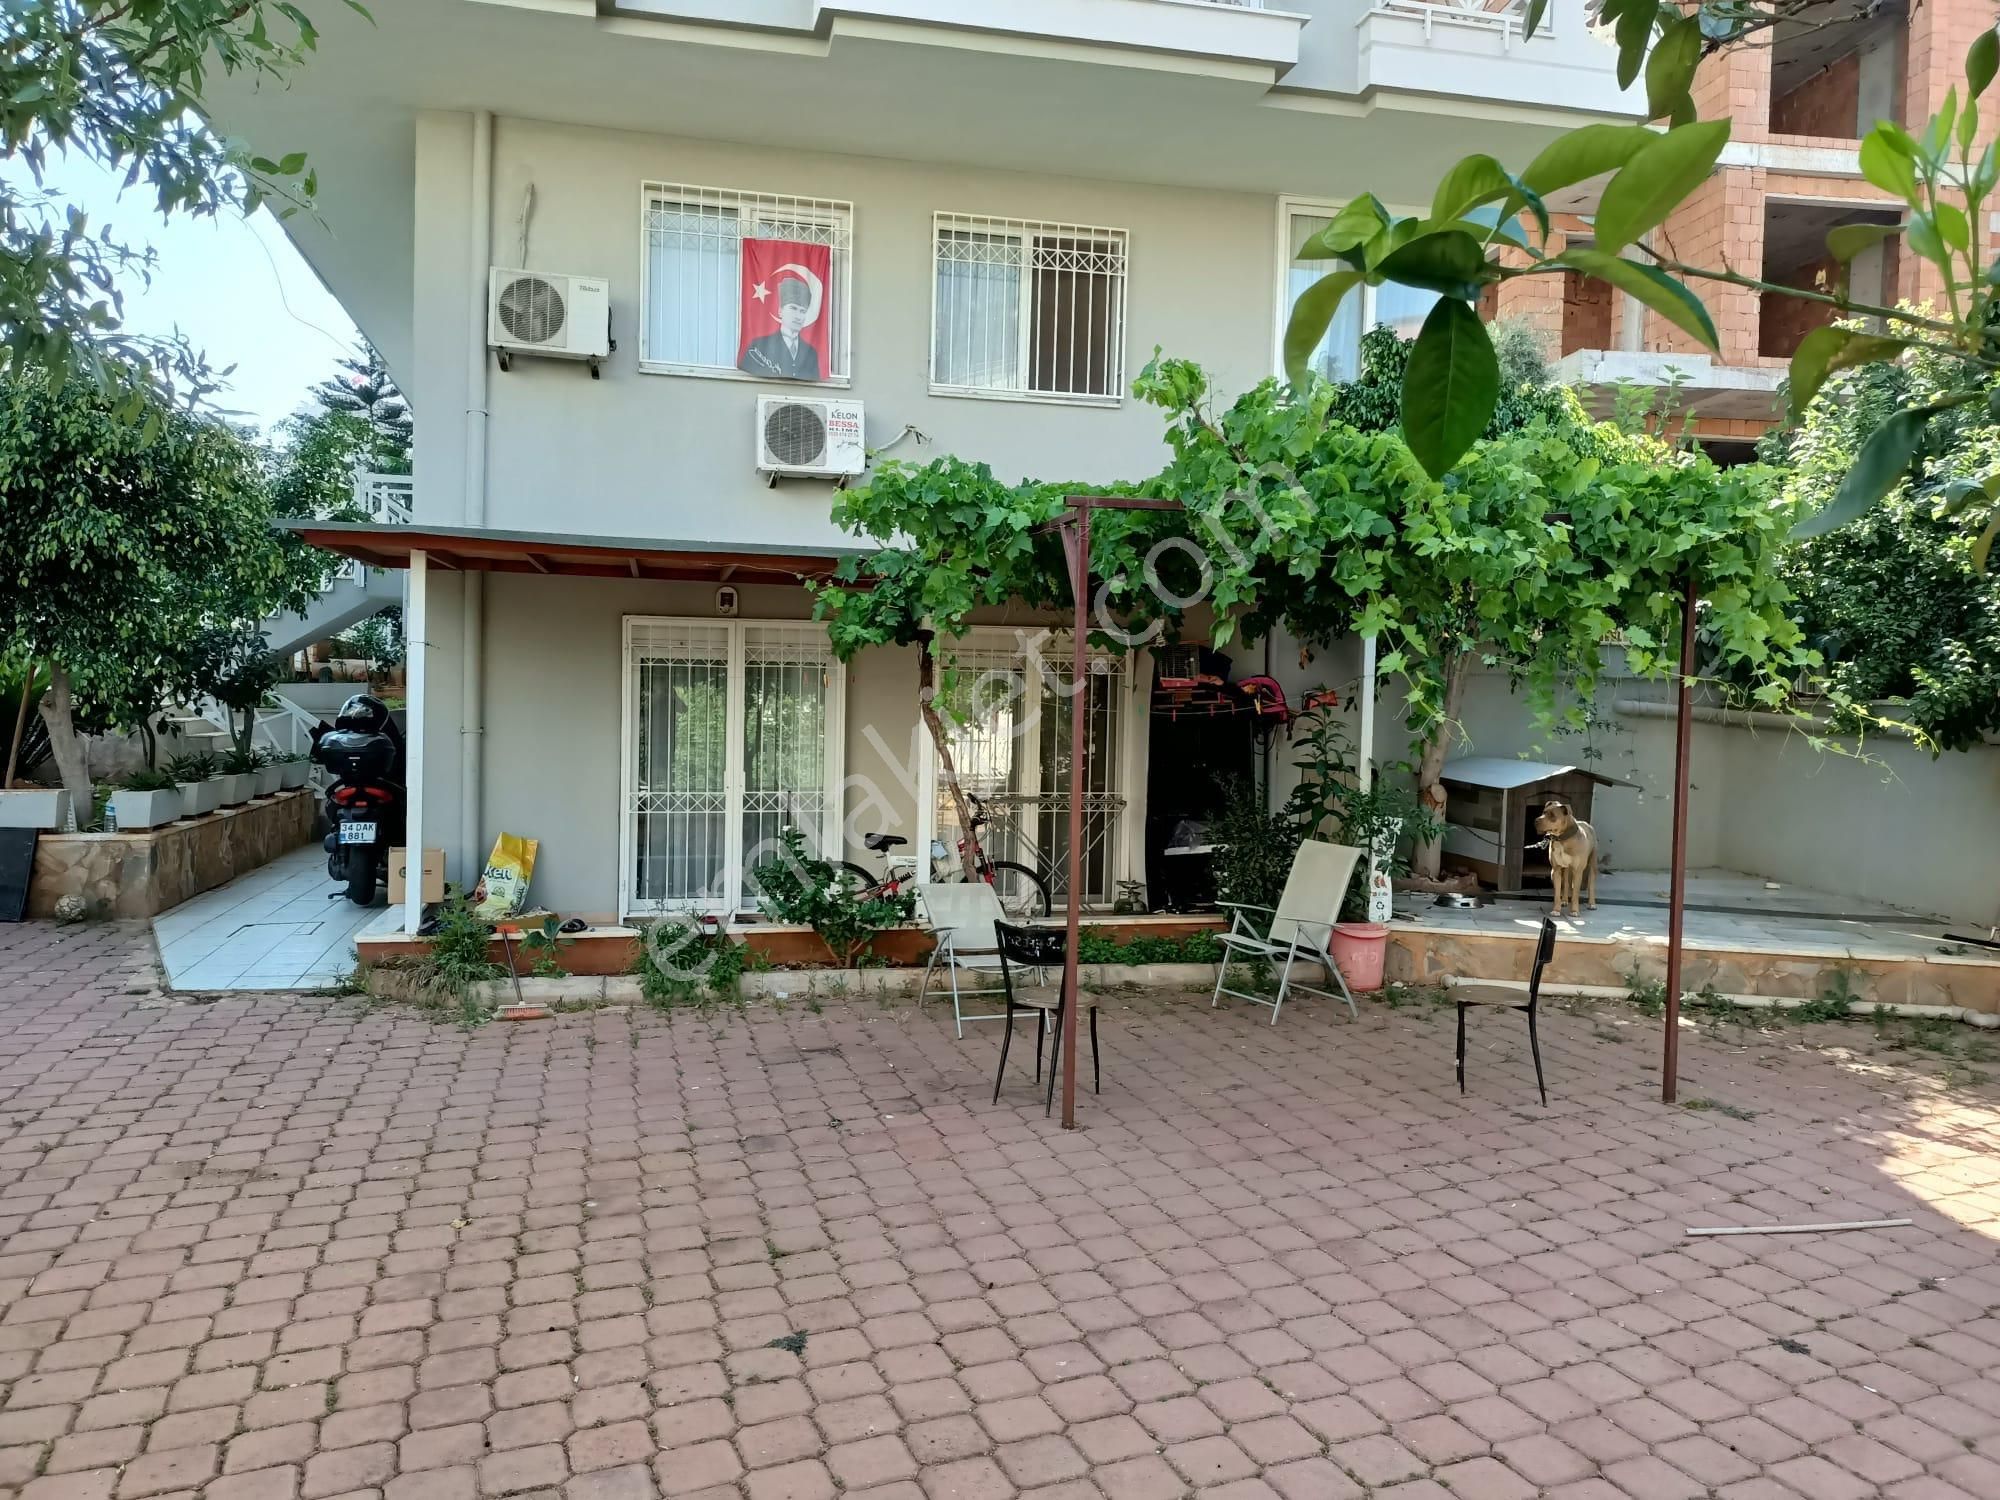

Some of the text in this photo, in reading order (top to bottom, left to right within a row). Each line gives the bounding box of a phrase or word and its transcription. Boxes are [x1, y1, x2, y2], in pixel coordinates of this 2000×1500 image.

[831, 410, 857, 419] KELON
[356, 823, 374, 831] DAK
[347, 832, 364, 840] 881
